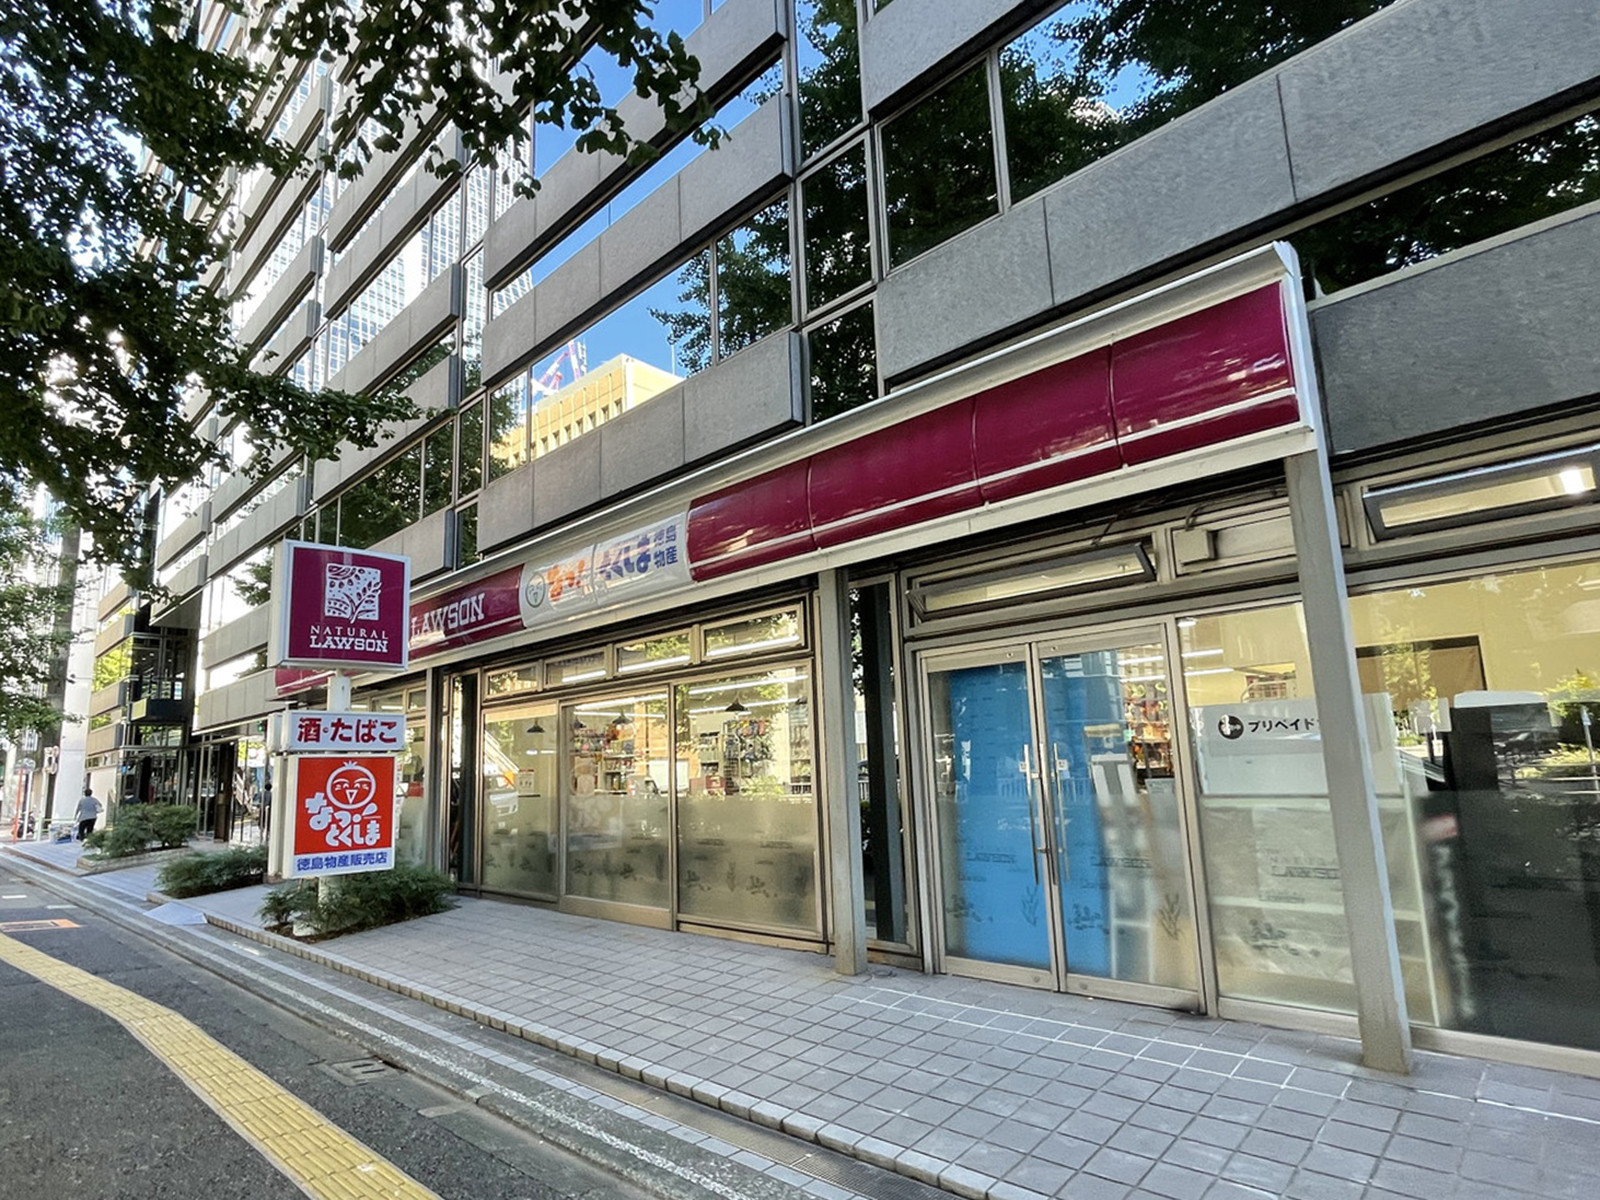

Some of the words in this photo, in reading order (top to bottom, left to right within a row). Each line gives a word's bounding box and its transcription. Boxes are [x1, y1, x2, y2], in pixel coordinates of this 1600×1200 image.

[653, 545, 679, 569] 物産
[410, 592, 486, 638] LAWSON
[310, 625, 388, 640] NATURAL
[309, 635, 388, 653] LAWSON
[1248, 717, 1317, 733] プリペイド
[296, 850, 388, 872] 徳島物産販売店
[1270, 865, 1341, 881] LAWSO
